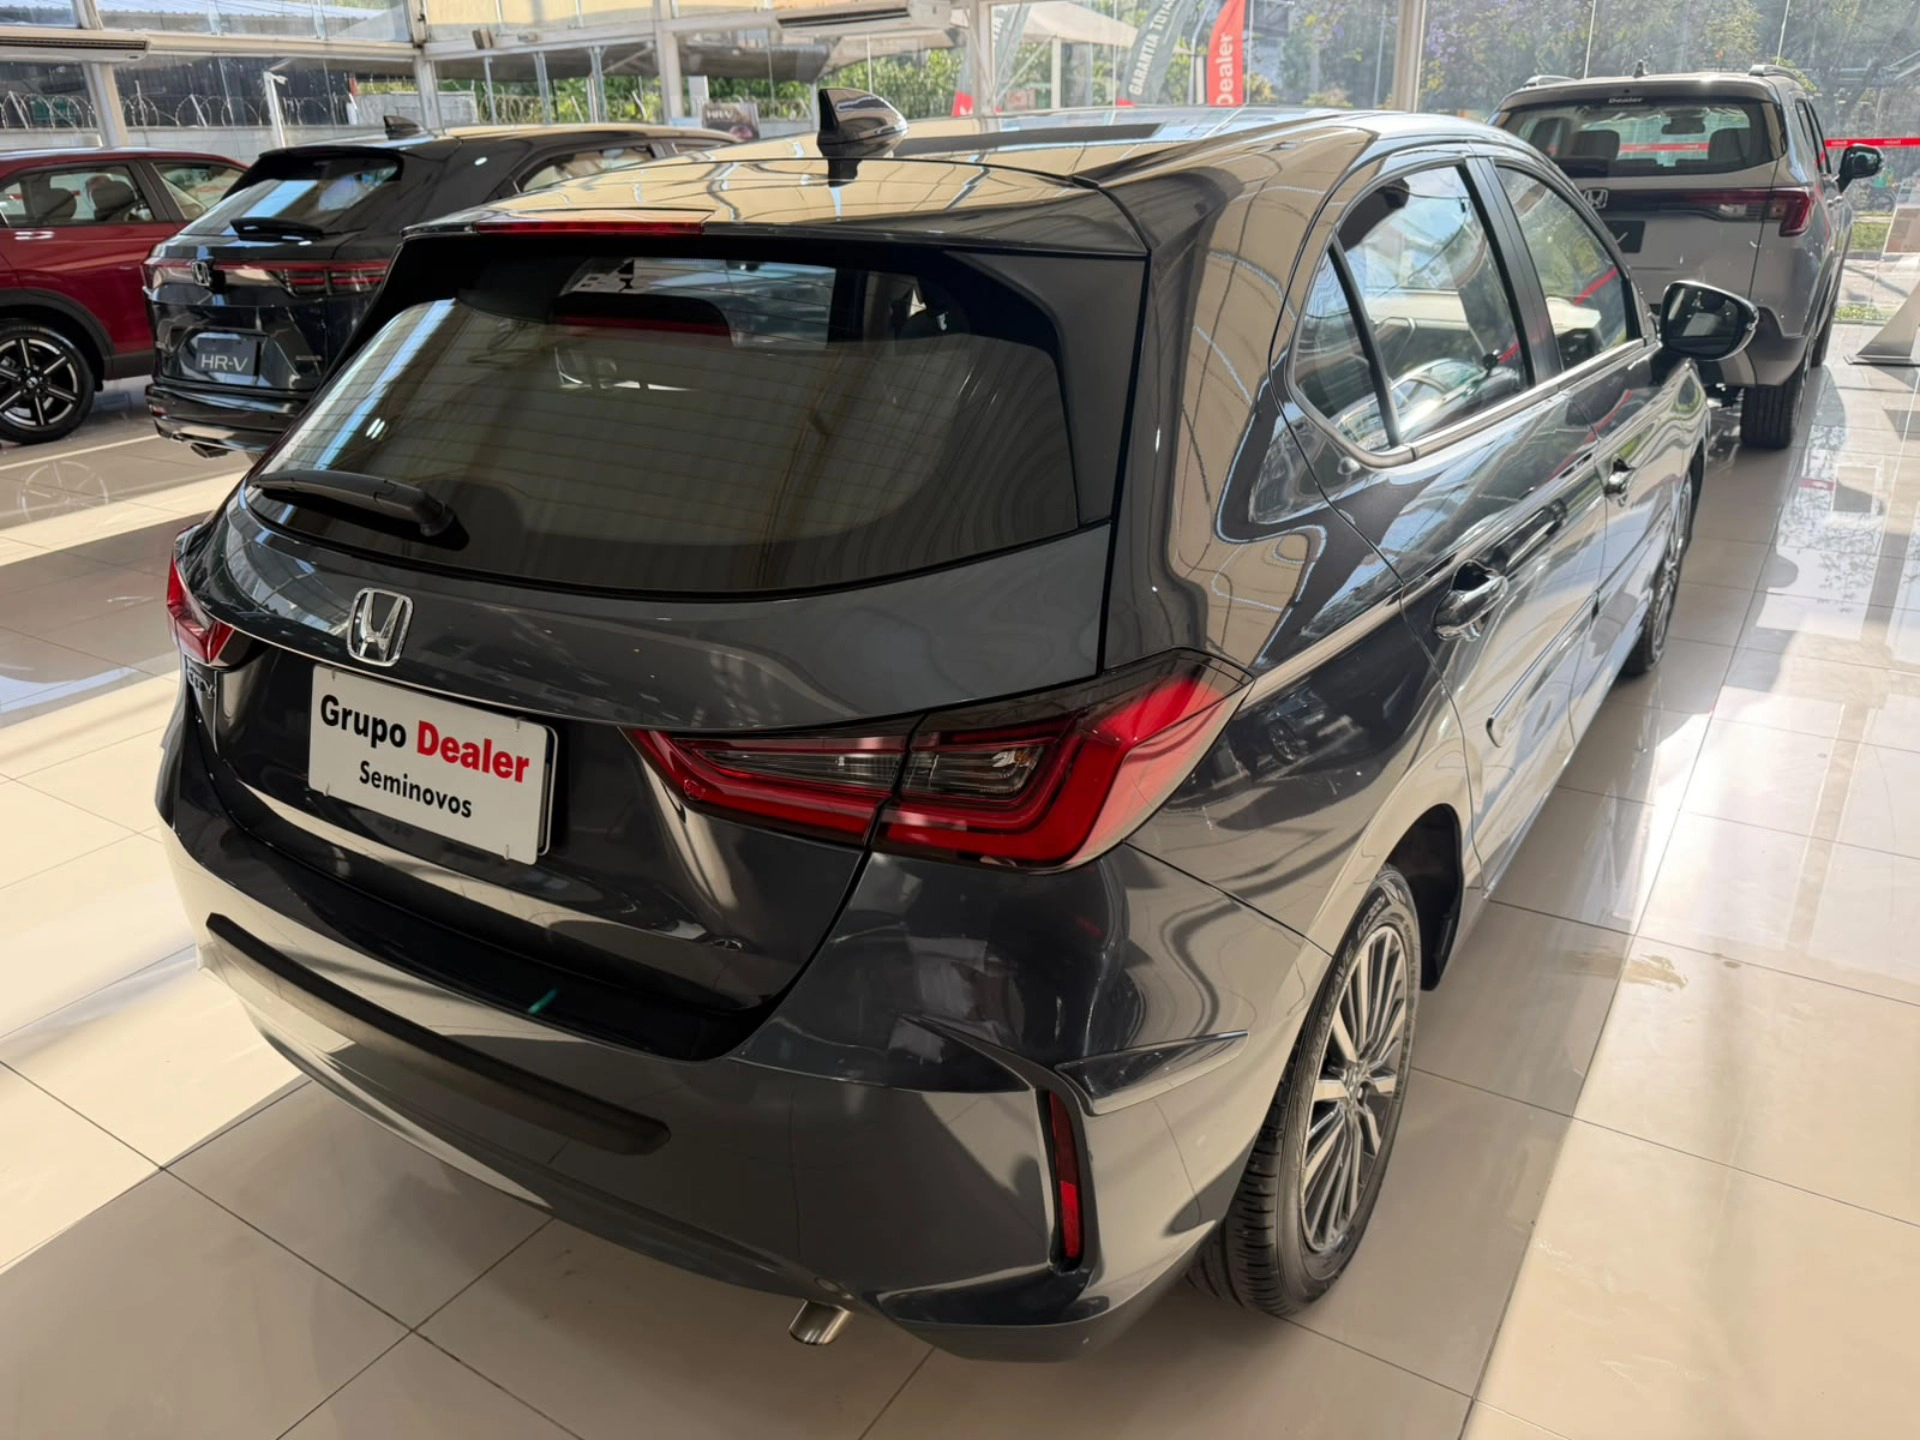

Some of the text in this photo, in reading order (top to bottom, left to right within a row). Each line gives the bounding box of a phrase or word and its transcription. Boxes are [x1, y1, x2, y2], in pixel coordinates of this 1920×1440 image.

[1128, 33, 1160, 96] GARANTIA
[200, 354, 248, 373] HR-V
[320, 694, 530, 784] Grupo Dealer
[359, 760, 473, 818] Seminovos
